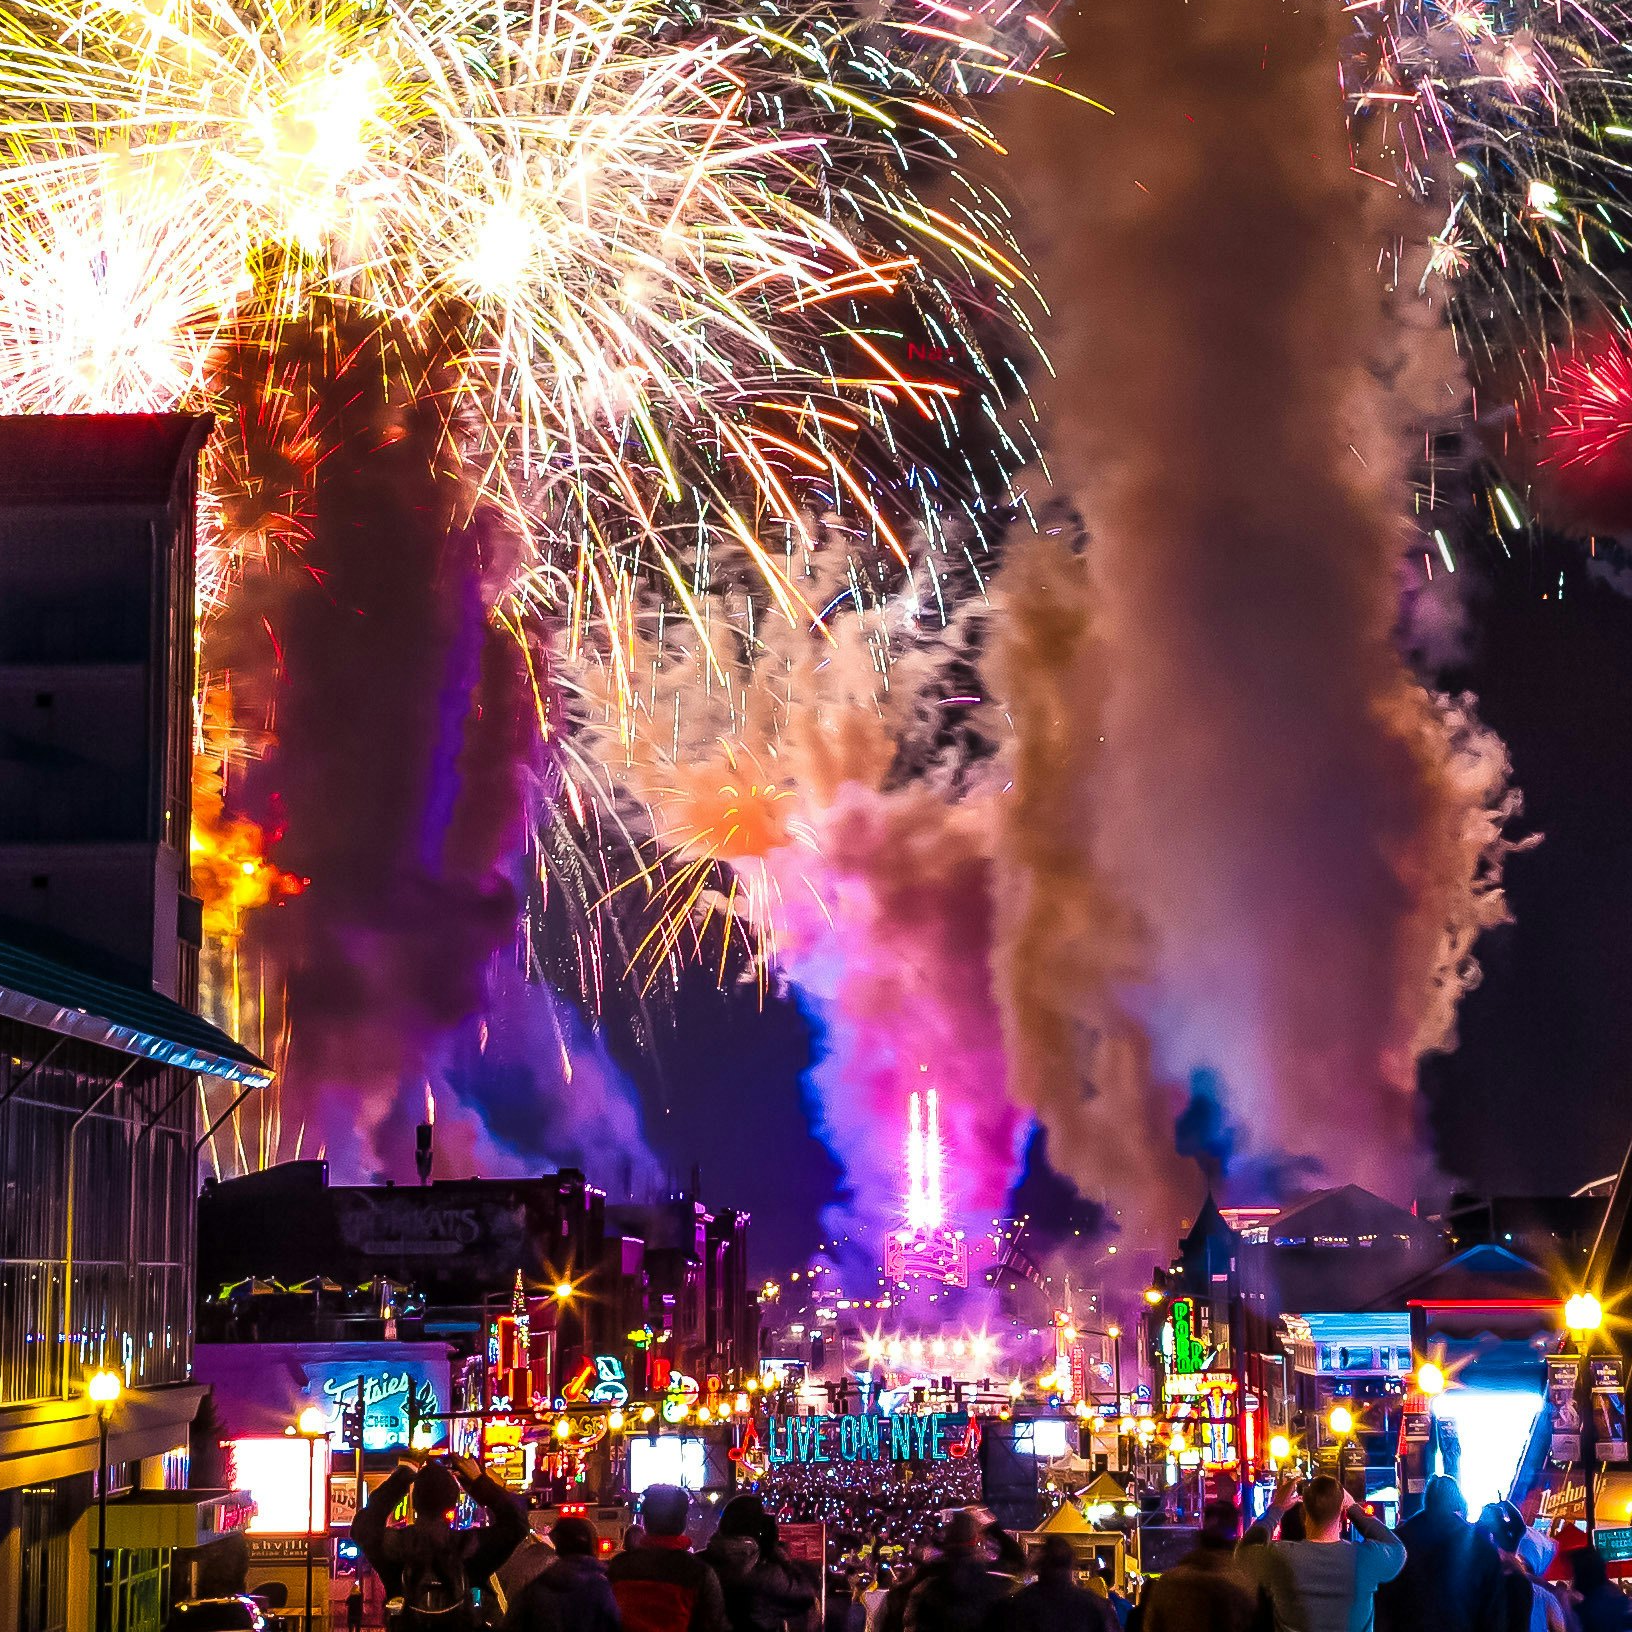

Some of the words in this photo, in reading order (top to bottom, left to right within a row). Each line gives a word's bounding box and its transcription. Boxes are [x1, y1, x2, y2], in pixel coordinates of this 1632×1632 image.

[323, 1371, 409, 1424] Ttsies
[769, 1415, 831, 1463] LIVE
[840, 1414, 879, 1461] ON
[891, 1413, 947, 1460] NYE
[252, 1539, 309, 1550] shvill
